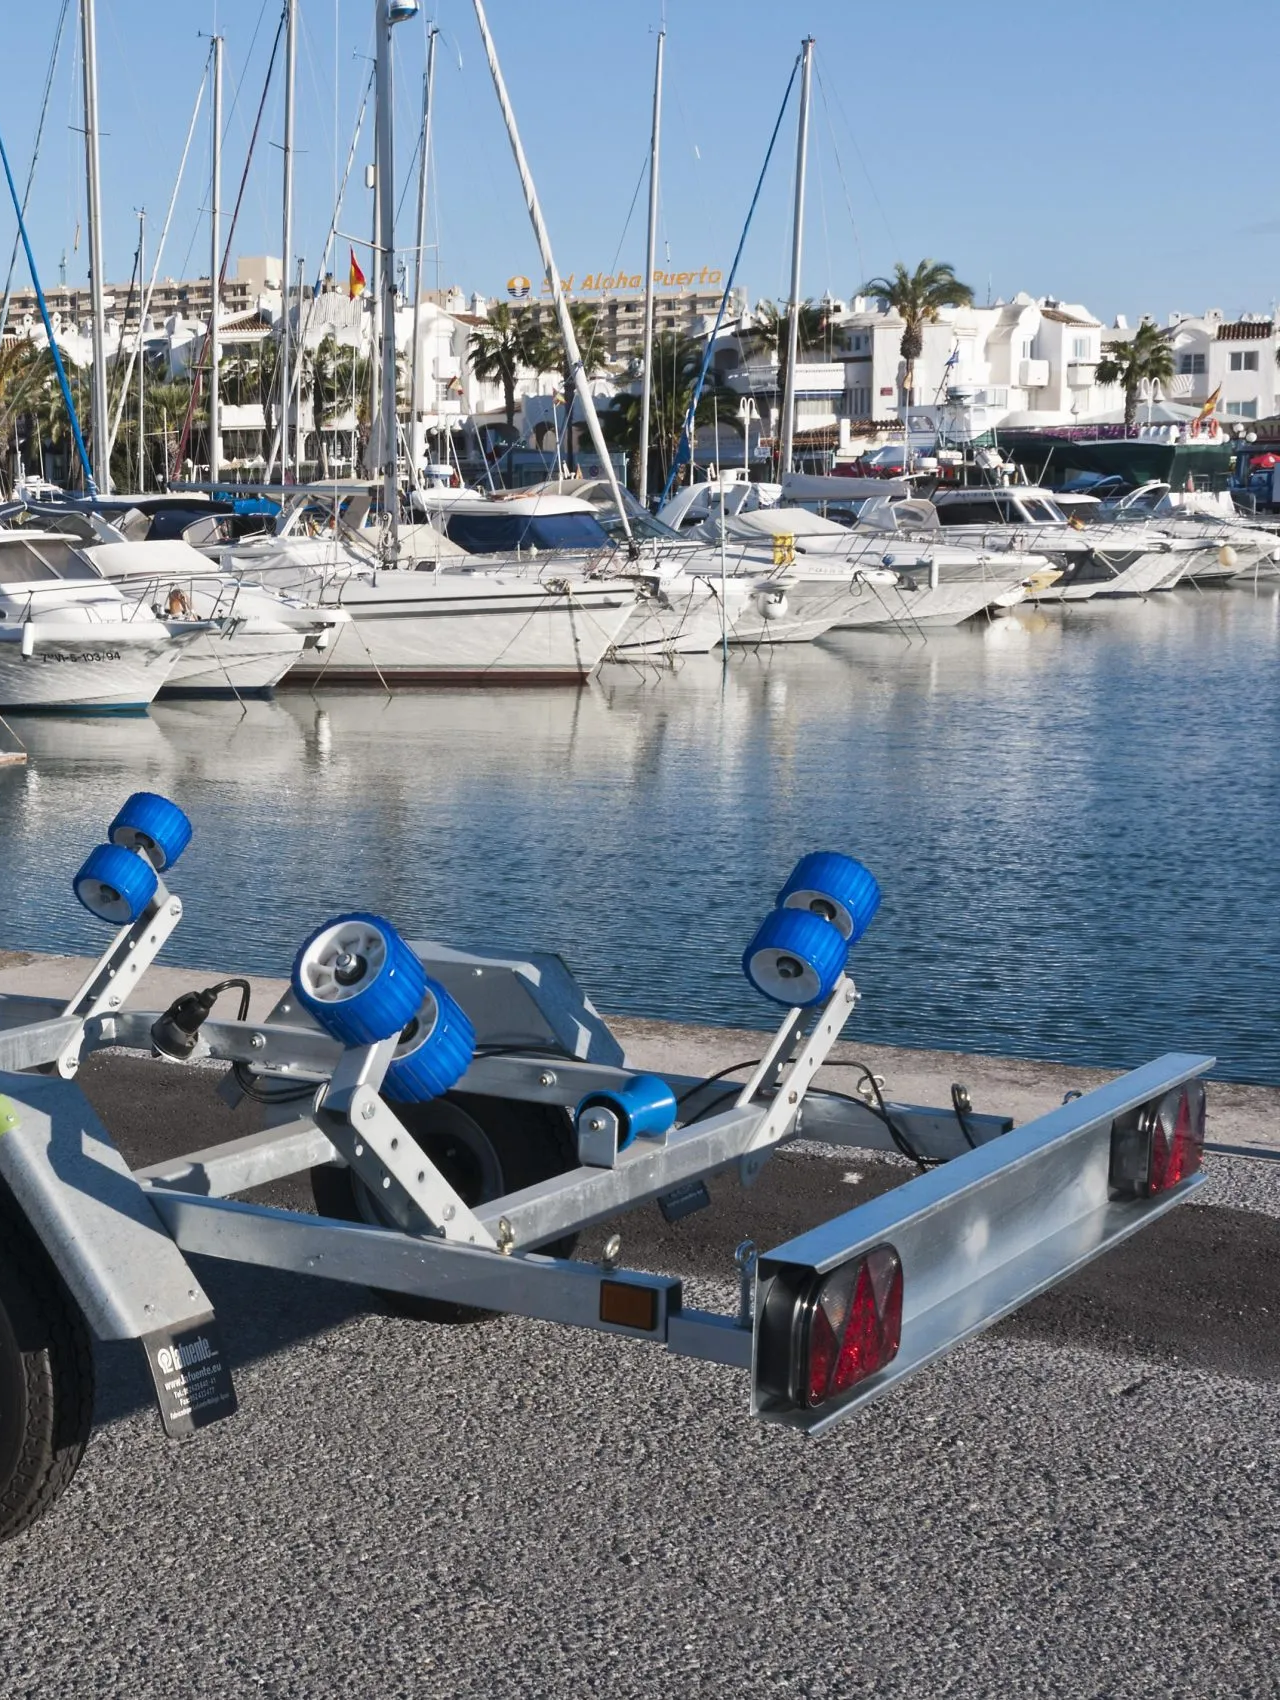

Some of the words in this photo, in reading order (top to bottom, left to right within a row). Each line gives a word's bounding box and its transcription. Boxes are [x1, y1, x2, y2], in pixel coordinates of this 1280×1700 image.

[580, 271, 642, 290] Aloha
[653, 265, 722, 287] Puerto
[169, 1336, 211, 1371] lafuente
